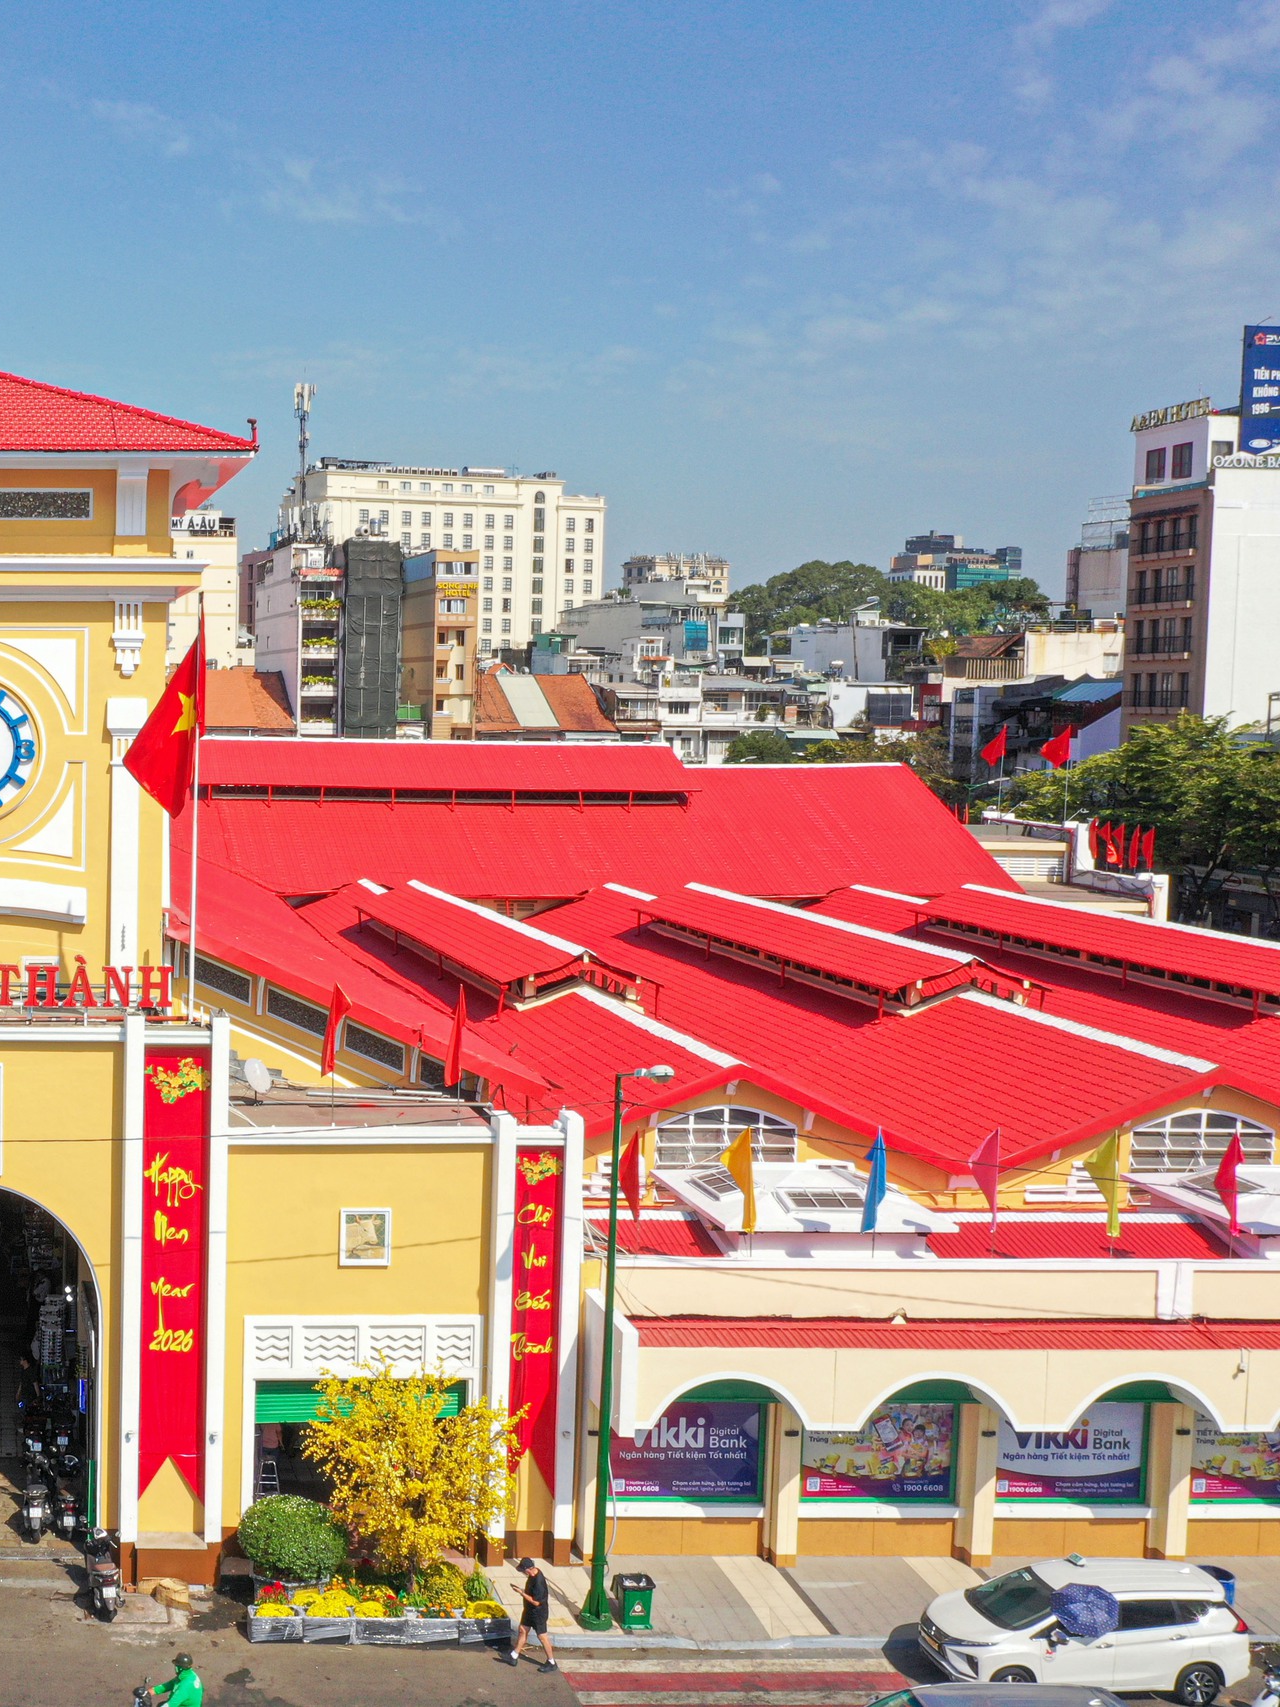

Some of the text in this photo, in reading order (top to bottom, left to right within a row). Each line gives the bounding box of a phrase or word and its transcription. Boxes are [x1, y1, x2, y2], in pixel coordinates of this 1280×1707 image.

[1213, 455, 1263, 468] OZONE
[16, 739, 35, 761] 3
[144, 1151, 204, 1207] Happy
[517, 1203, 552, 1227] Chợ
[521, 1243, 547, 1269] Vui
[151, 1276, 196, 1330] Year
[514, 1289, 551, 1311] Bến
[149, 1328, 195, 1352] 2026
[510, 1332, 553, 1362] Thành
[709, 1428, 739, 1436] Digital
[1093, 1429, 1122, 1438] Digital
[1196, 1427, 1212, 1436] TIẾT
[709, 1436, 747, 1448] Bank
[1092, 1438, 1130, 1449] Bank
[620, 1450, 747, 1460] Ngân hàng Tiết kiệm Tốt nhất!
[1003, 1452, 1130, 1462] Ngân hàng Tiết kiệm Tốt nhất!
